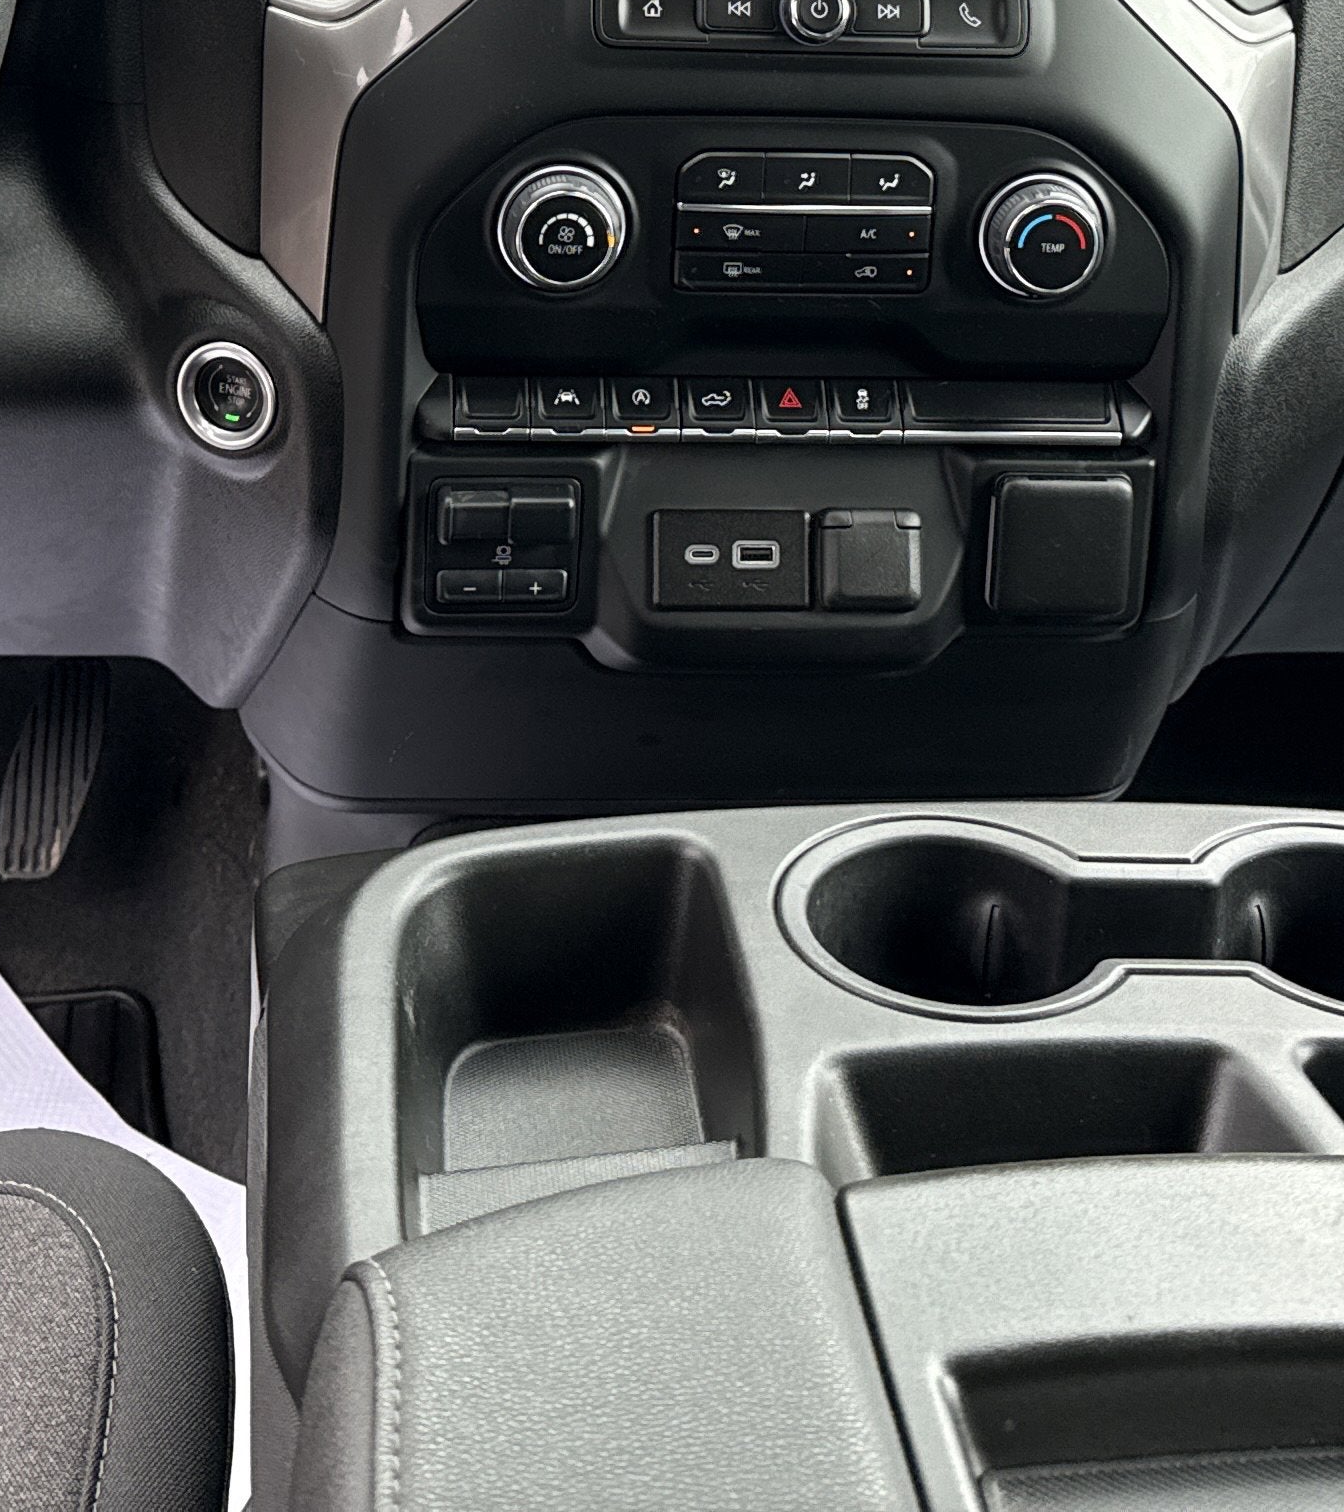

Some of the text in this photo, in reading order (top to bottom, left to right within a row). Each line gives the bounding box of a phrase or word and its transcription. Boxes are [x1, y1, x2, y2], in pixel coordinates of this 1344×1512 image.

[860, 228, 878, 240] A/C
[547, 244, 584, 256] ON/OFF
[1040, 242, 1065, 254] TEMP
[219, 382, 252, 400] ENGINE
